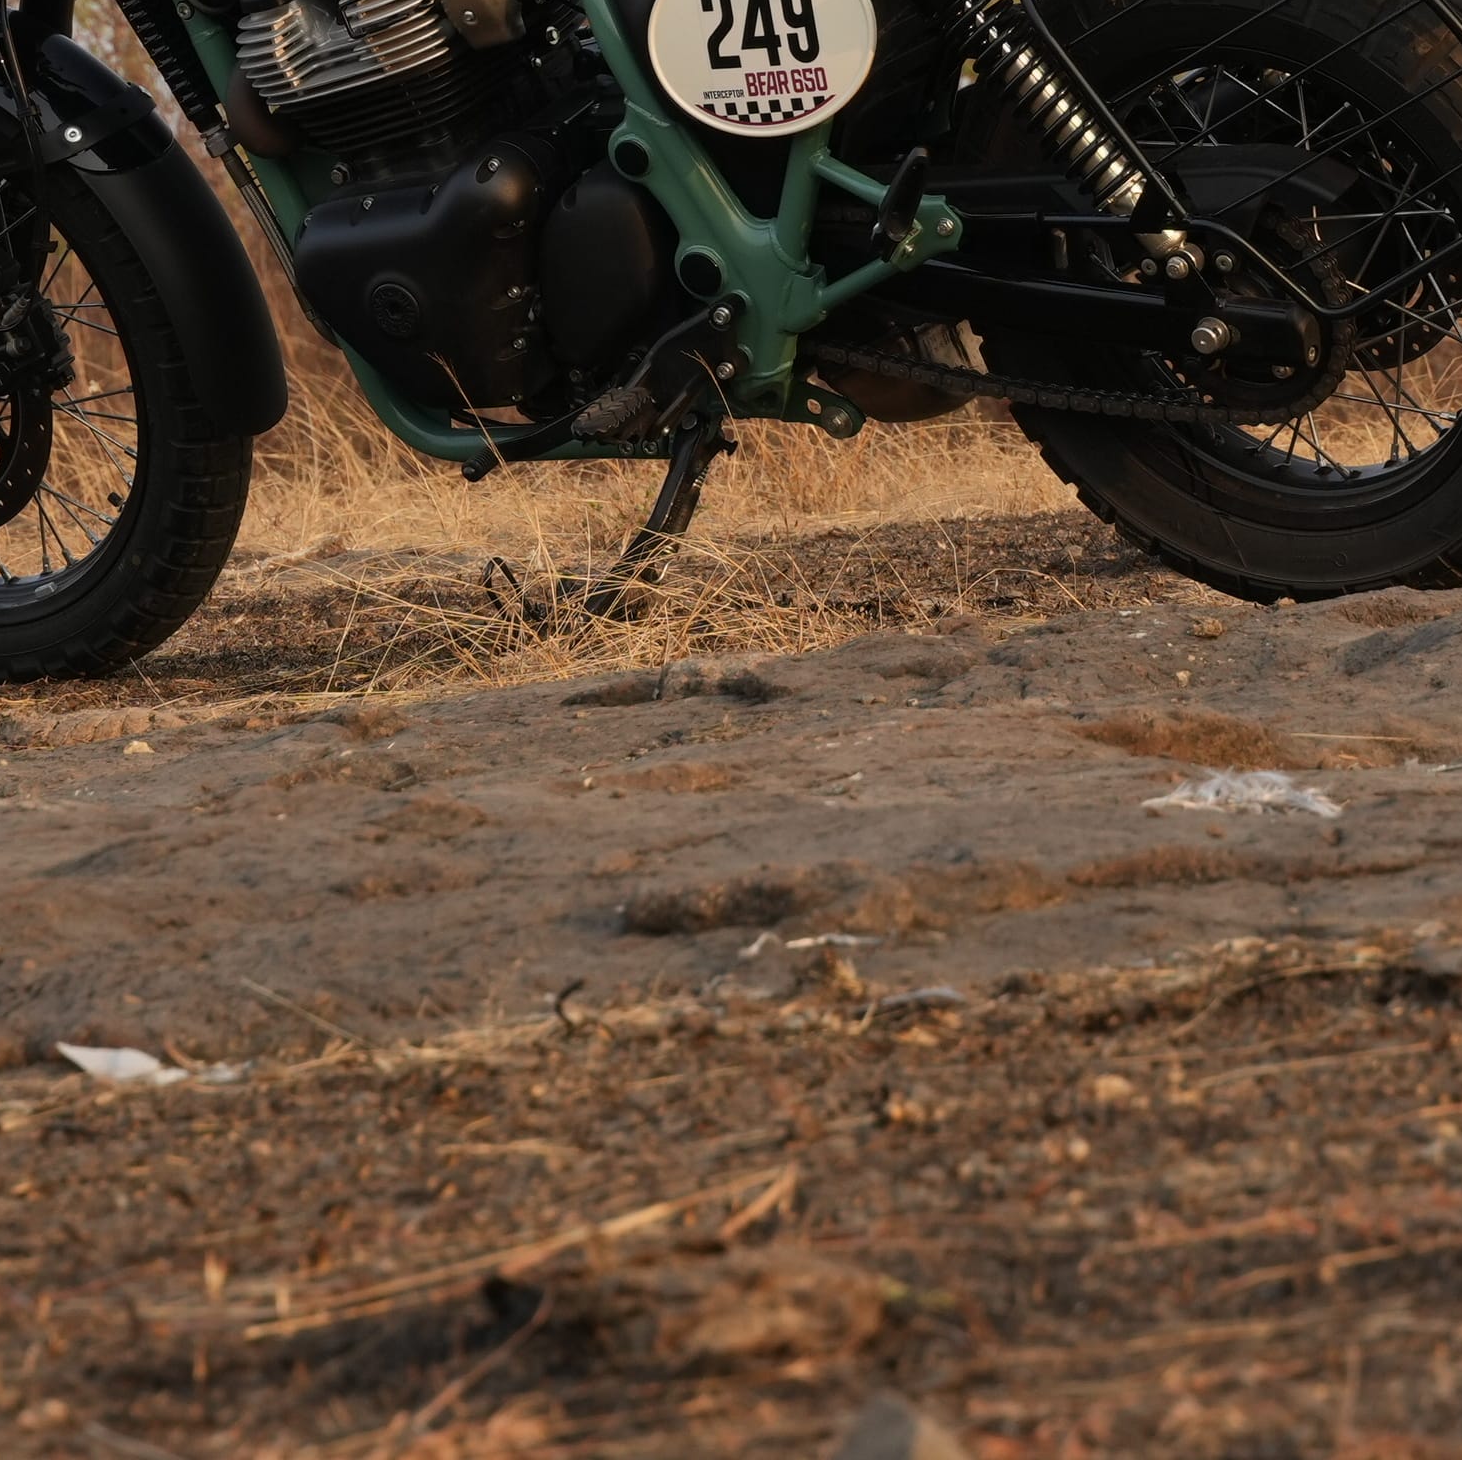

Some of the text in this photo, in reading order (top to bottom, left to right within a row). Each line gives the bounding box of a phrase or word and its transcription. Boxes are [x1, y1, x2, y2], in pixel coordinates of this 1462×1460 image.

[703, 67, 828, 100] INTERCEPTOR BEAR 650
